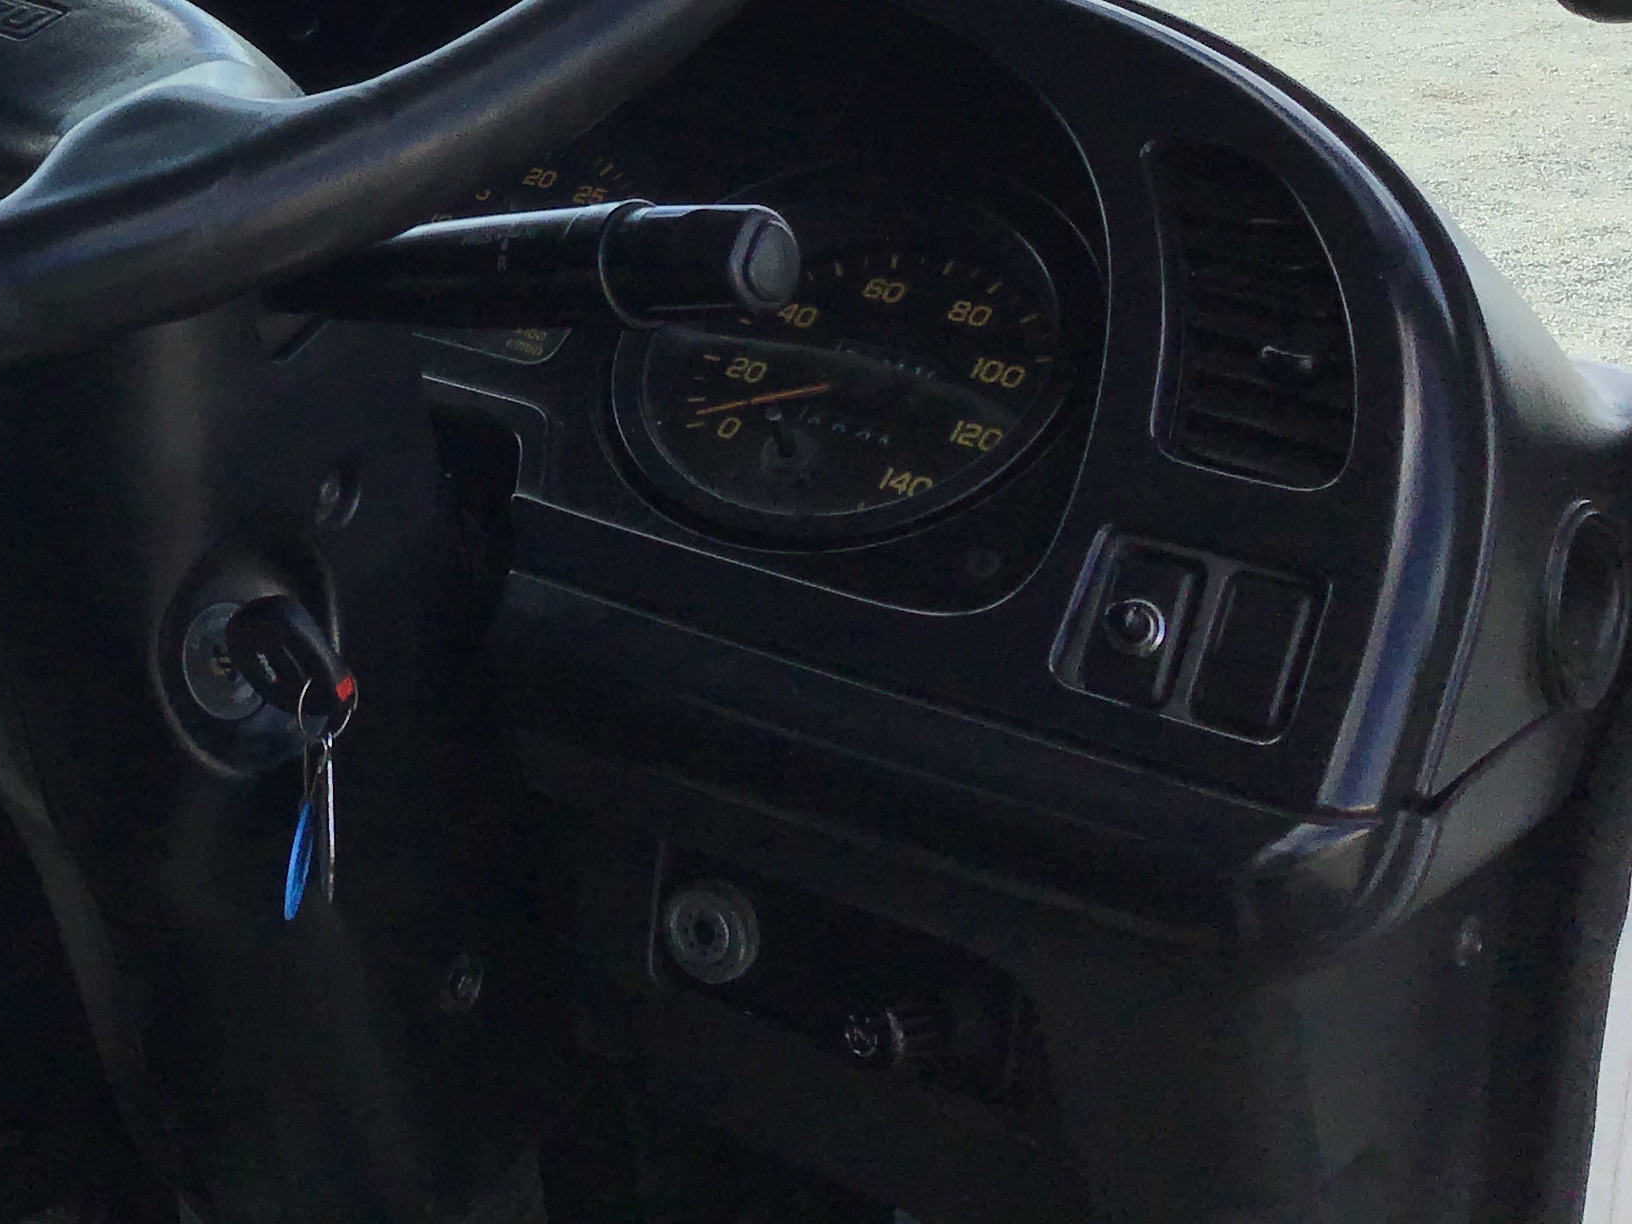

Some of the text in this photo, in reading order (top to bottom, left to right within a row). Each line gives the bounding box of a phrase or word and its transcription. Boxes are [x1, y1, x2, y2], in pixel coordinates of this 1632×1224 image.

[522, 167, 558, 189] 20
[572, 185, 608, 204] 25
[862, 277, 906, 304] 60
[777, 303, 819, 329] 40
[946, 300, 993, 327] 80
[725, 357, 768, 384] 20
[968, 357, 1027, 389] 100
[716, 416, 742, 440] 0
[948, 420, 1004, 452] 120
[878, 466, 934, 496] 140
